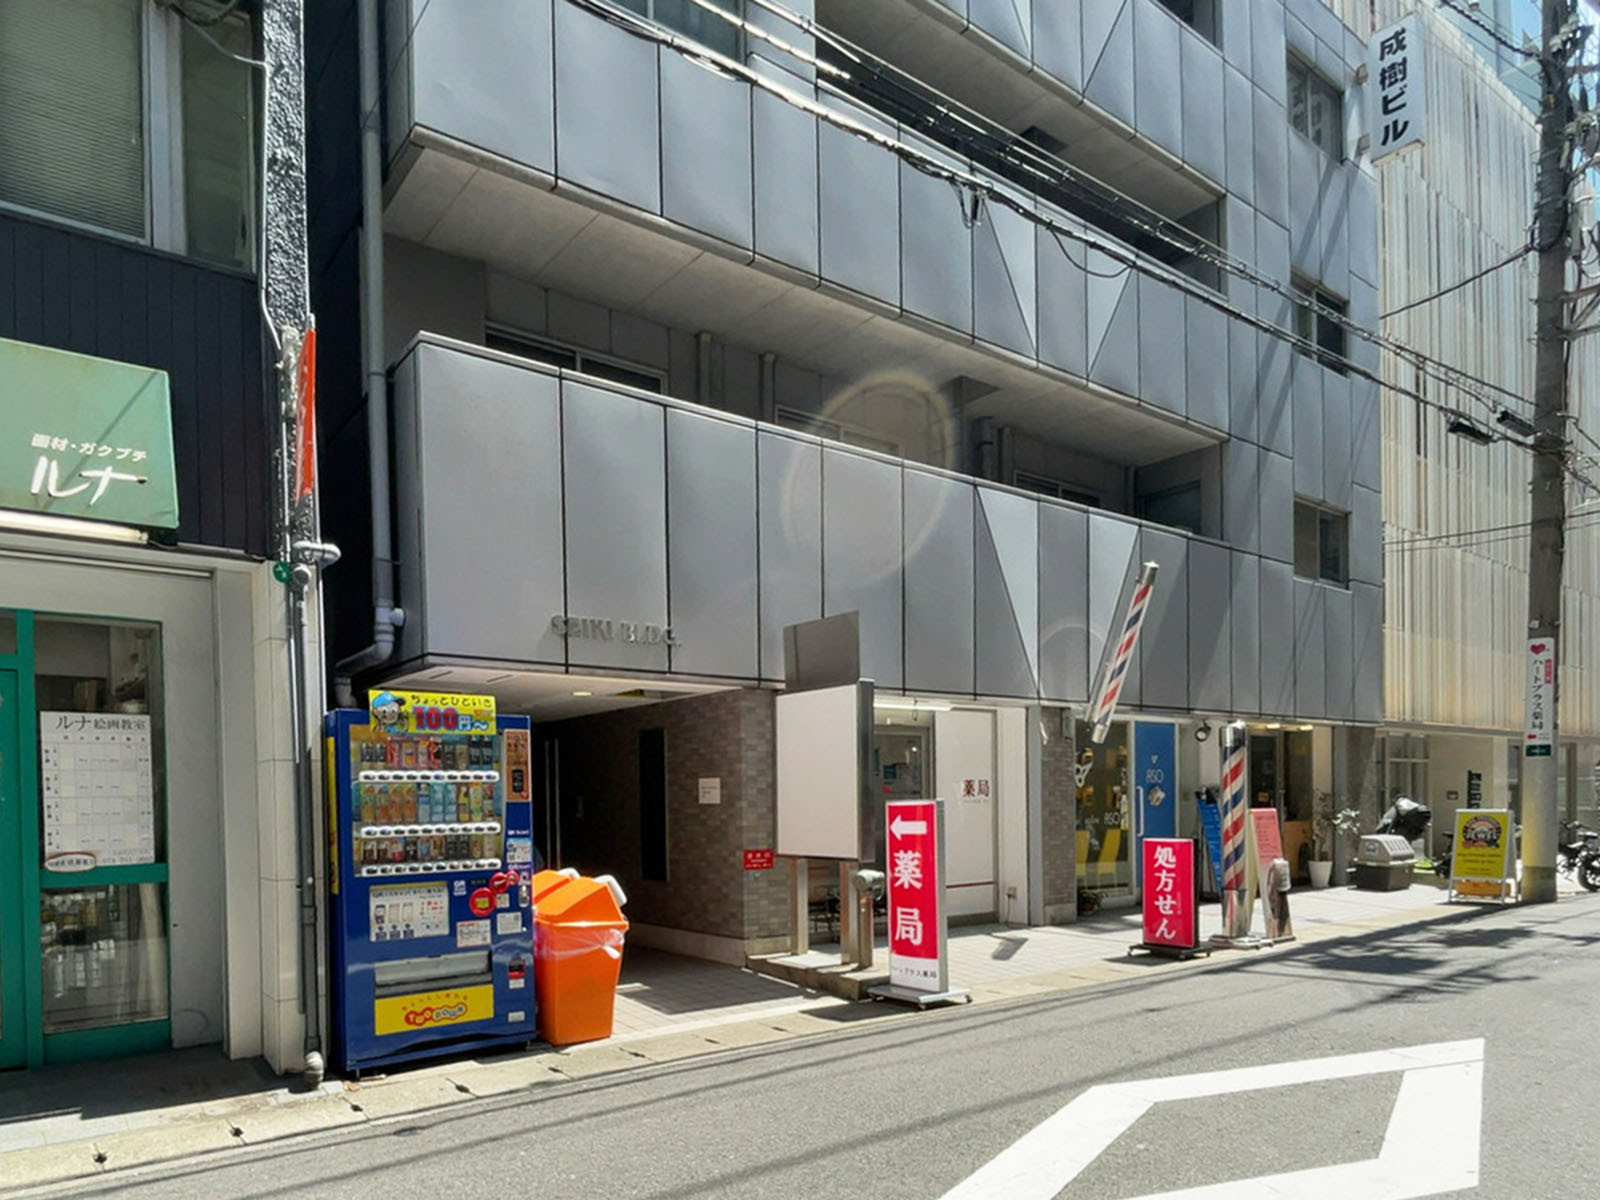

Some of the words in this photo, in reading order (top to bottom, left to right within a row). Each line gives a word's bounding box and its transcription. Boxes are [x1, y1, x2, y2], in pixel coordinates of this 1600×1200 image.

[1379, 27, 1409, 146] 成樹ビル
[31, 455, 147, 505] ルナ
[963, 779, 989, 798] 薬局
[893, 850, 922, 946] 薬局
[1154, 845, 1177, 940] 処方せん
